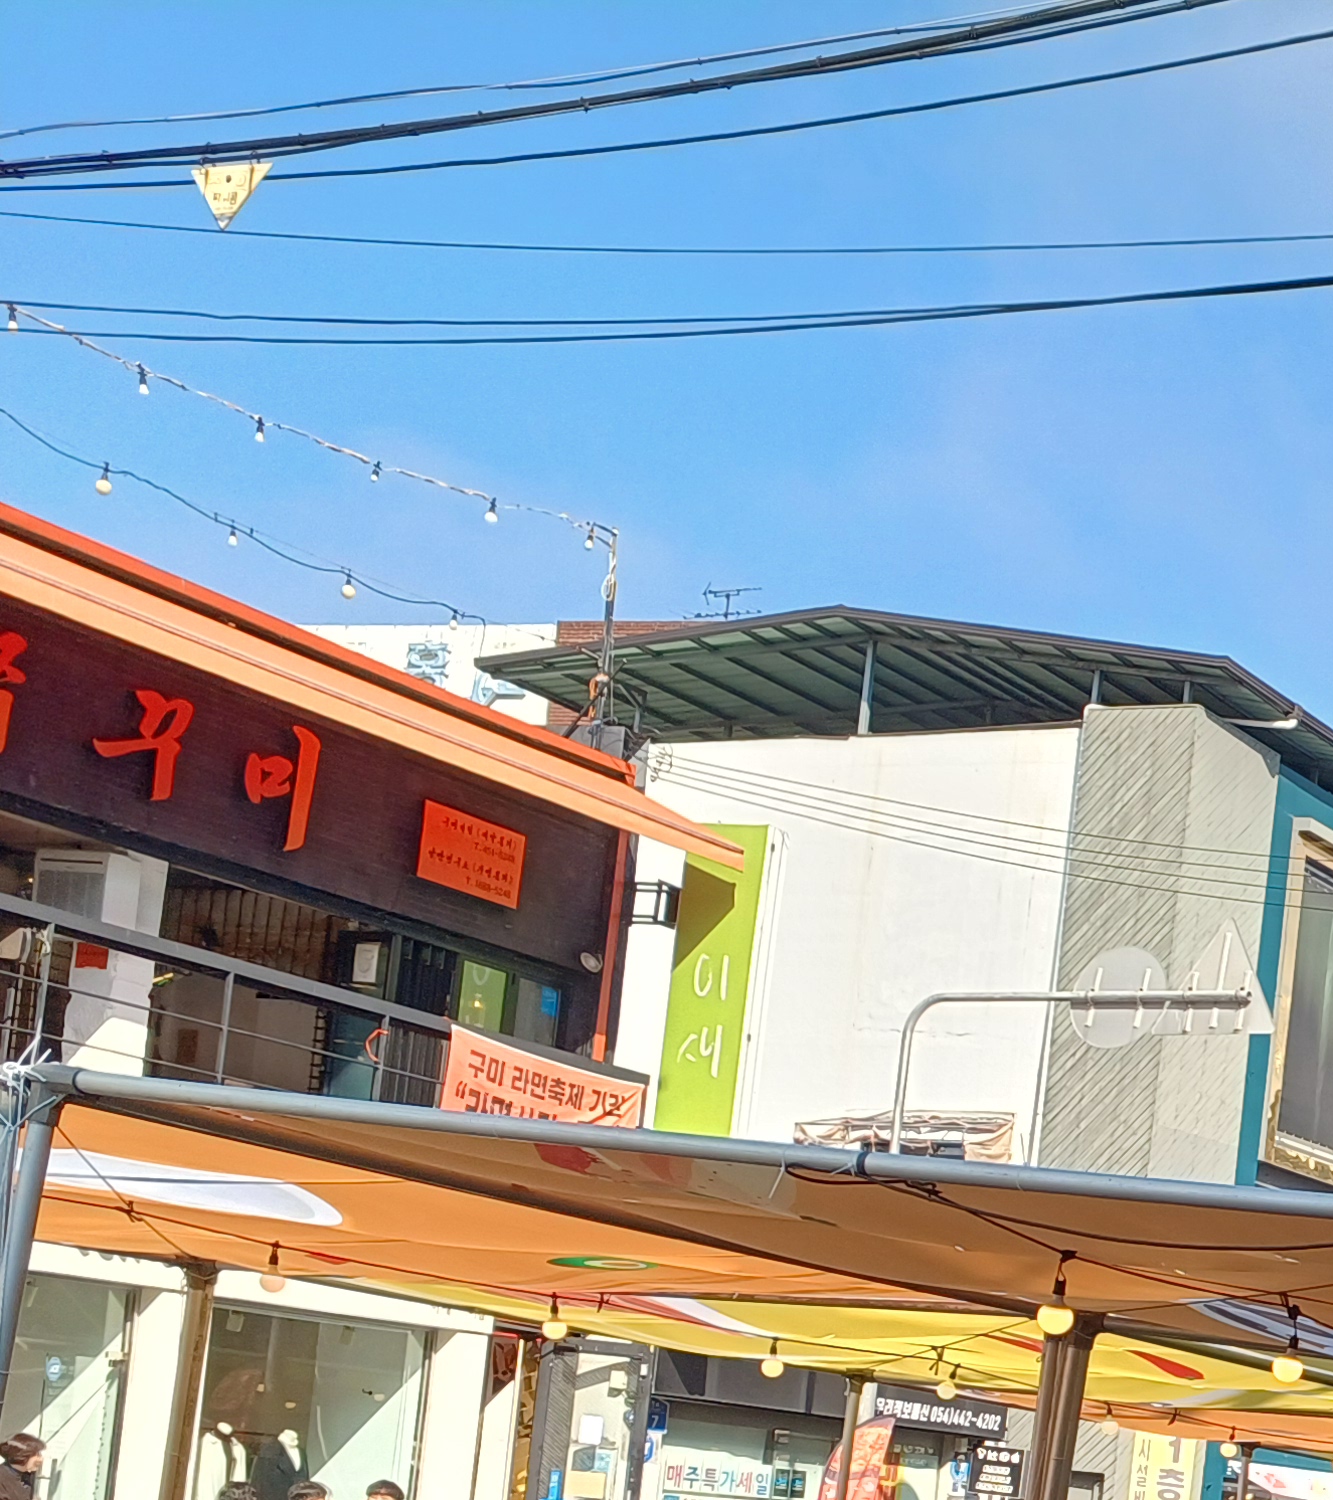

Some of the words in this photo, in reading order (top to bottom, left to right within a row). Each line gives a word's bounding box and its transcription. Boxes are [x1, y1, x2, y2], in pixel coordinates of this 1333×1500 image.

[468, 1049, 506, 1087] 구미
[510, 1065, 585, 1111] 라면축제
[651, 1414, 660, 1429] 7
[930, 1406, 1002, 1432] 054)442-4202
[666, 1463, 770, 1496] 매주특가세일
